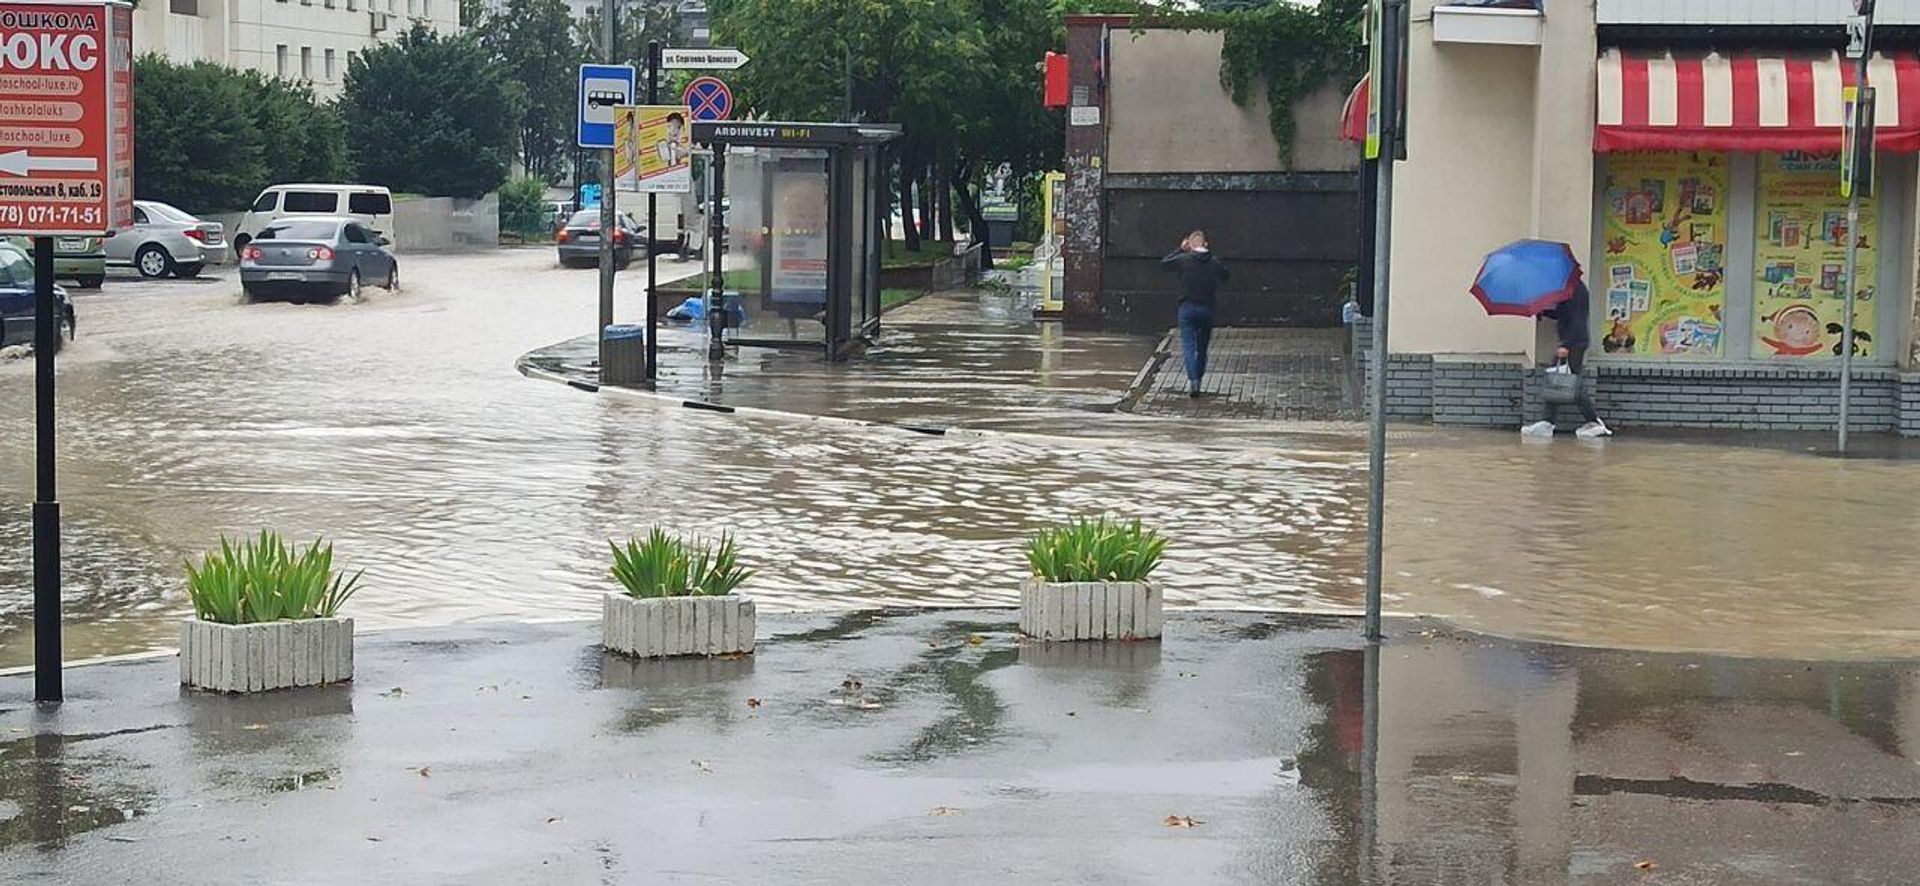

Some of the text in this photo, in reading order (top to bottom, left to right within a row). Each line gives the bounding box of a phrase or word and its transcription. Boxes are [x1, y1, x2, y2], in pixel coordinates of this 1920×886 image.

[1, 11, 98, 30] ОШКОЛА
[0, 33, 97, 71] ЮКС
[715, 127, 776, 137] ARDINVEST
[90, 183, 102, 198] 19
[28, 206, 101, 224] 071-71-51
